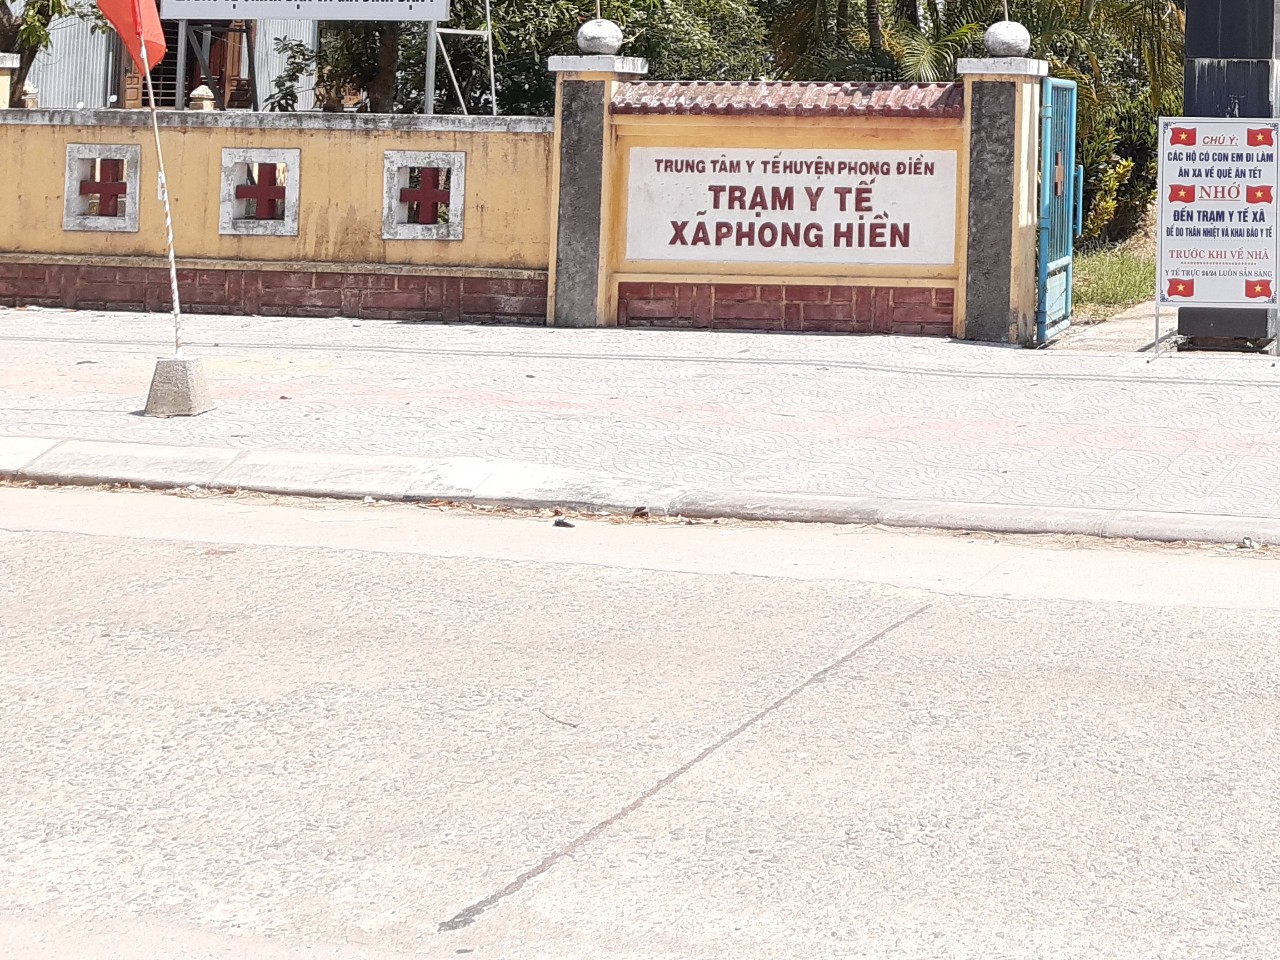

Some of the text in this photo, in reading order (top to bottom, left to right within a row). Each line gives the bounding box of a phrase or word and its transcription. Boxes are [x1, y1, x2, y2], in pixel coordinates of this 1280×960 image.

[1202, 134, 1226, 145] CHÚ
[1167, 150, 1274, 164] CÁC HỘ CÓ CON EM ĐI LÀM
[654, 158, 706, 173] TRUNG
[710, 154, 741, 174] TÂM
[745, 159, 756, 173] Y
[760, 151, 782, 174] TẾ
[782, 155, 835, 180] HUYỆN
[837, 160, 891, 176] PHONG
[1191, 168, 1203, 178] XA
[1216, 166, 1233, 179] QUÊ
[1248, 166, 1262, 179] TẾT
[707, 177, 877, 218] TRẠM Y TẾ
[1199, 182, 1241, 199] NHỚ
[1173, 206, 1194, 222] ĐẾN
[1196, 210, 1225, 225] TRẠM
[1228, 210, 1234, 222] Y
[1237, 207, 1250, 222] TẾ
[668, 209, 712, 246] XÃ
[714, 221, 824, 248] PHONG
[1221, 225, 1229, 238] VÀ
[1230, 227, 1245, 238] KHAI
[1260, 227, 1264, 238] Y
[1265, 225, 1273, 238] TẾ
[1208, 249, 1227, 259] KHI
[1246, 248, 1270, 260] NHÀ
[1171, 267, 1180, 276] TẾ
